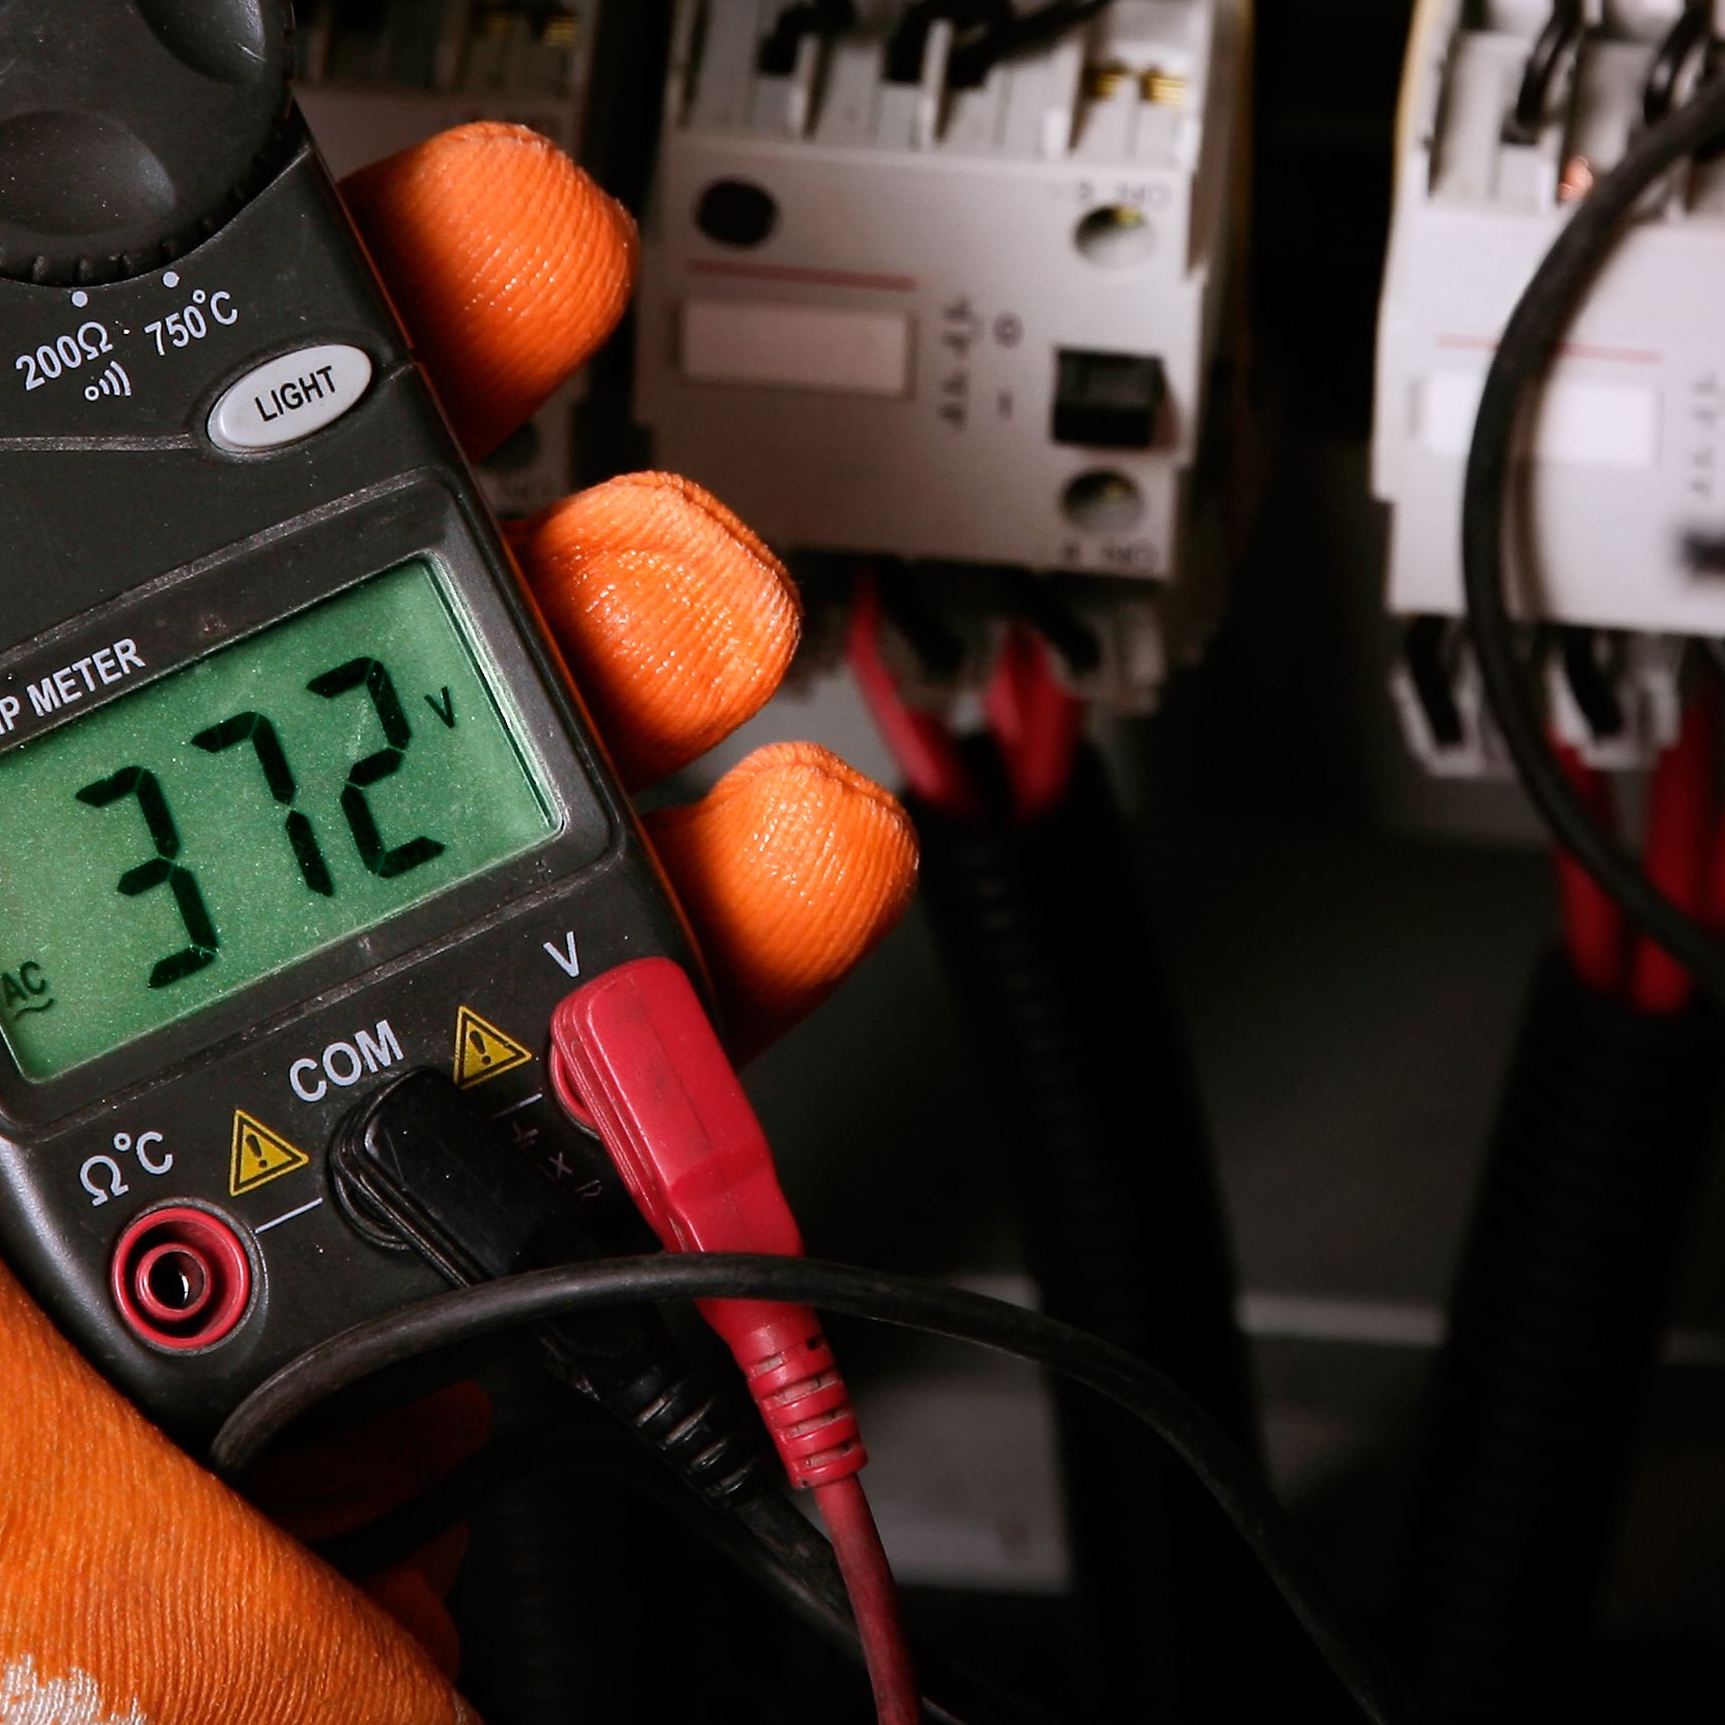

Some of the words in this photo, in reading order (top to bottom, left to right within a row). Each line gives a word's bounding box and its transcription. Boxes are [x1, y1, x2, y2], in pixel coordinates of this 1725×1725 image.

[15, 321, 114, 391] 200Ω
[254, 365, 339, 422] LIGHT
[26, 638, 147, 717] METER
[75, 656, 446, 989] 372
[423, 686, 456, 729] V
[2, 960, 50, 1008] AC
[542, 931, 579, 978] V
[289, 1019, 405, 1103] COM
